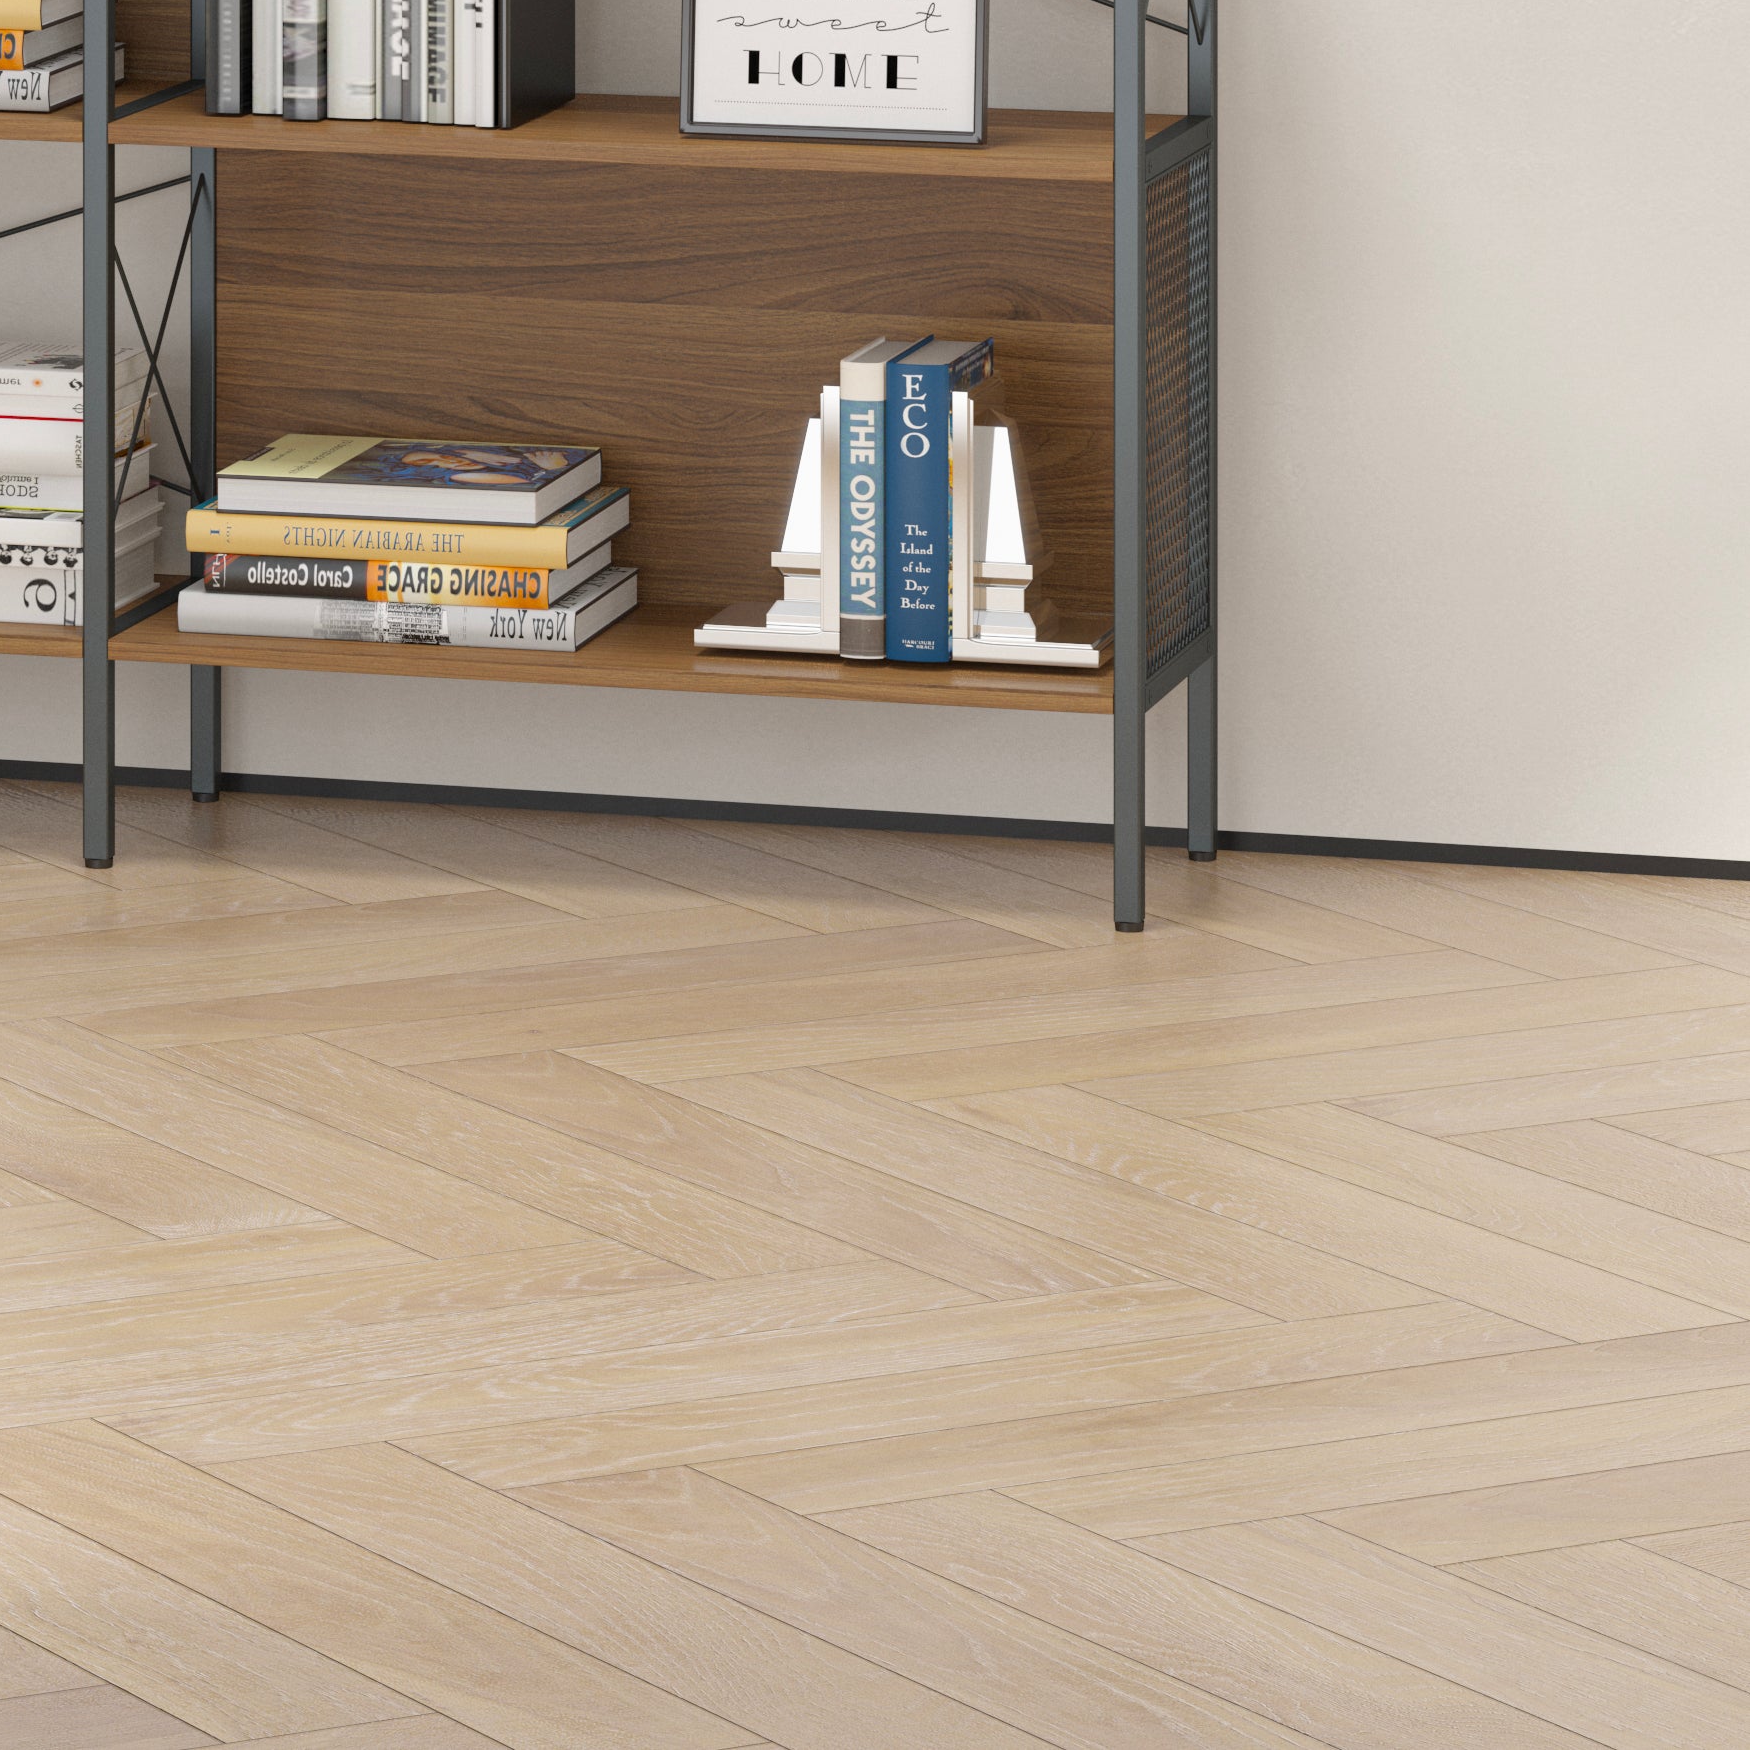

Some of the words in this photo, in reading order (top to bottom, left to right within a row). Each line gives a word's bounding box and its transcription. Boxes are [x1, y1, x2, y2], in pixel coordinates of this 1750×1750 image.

[716, 2, 949, 34] sweet
[742, 50, 919, 90] HOME
[900, 374, 930, 458] ECO
[850, 410, 876, 465] THE
[850, 474, 876, 608] ODYSSEY
[904, 524, 928, 537] The
[900, 542, 934, 556] Island
[902, 562, 912, 572] of
[915, 562, 932, 574] the
[905, 579, 930, 595] Day
[900, 596, 936, 610] Before
